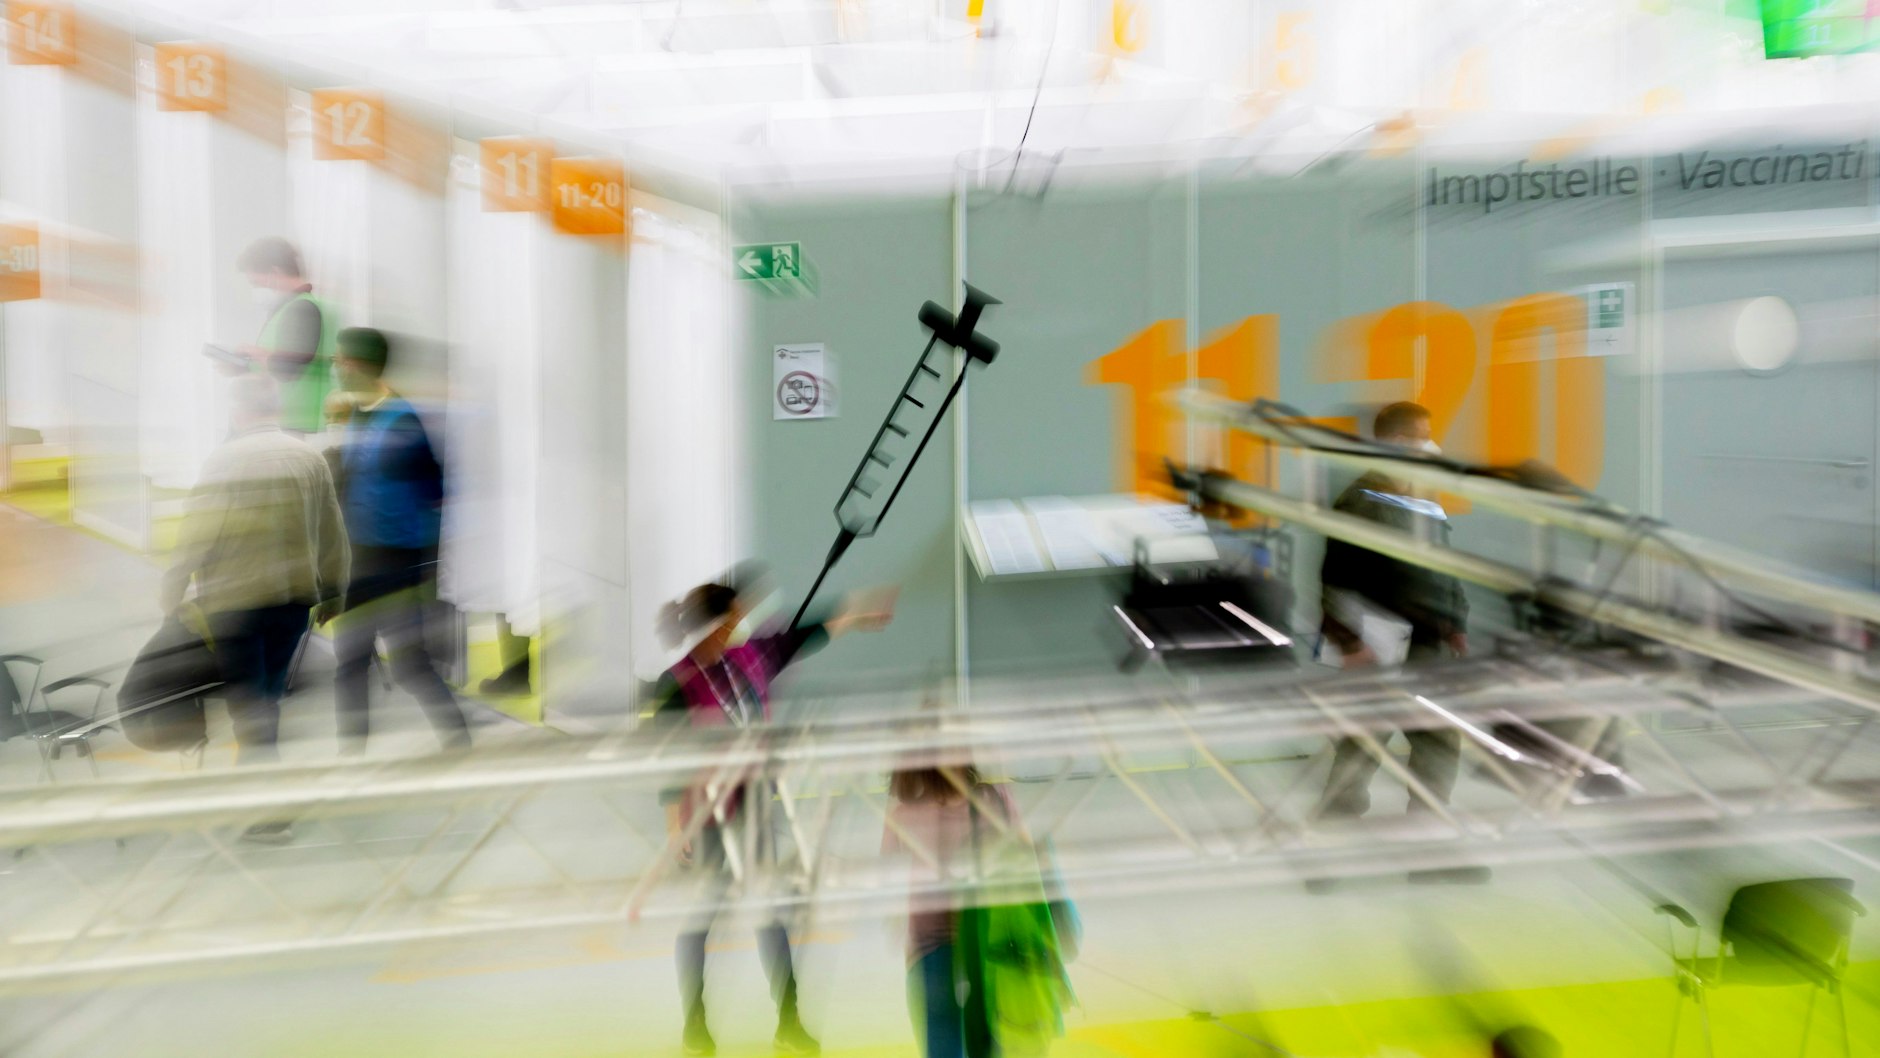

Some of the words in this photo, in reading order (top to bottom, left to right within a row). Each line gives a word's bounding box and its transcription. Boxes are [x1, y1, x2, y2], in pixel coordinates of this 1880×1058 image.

[18, 10, 64, 51] 14
[167, 54, 215, 98] 13
[323, 101, 374, 145] 12
[497, 151, 539, 197] 11
[557, 181, 621, 208] 11-20
[1428, 156, 1640, 213] Impfstelle
[1676, 139, 1880, 190] Vaccinati
[1092, 293, 1605, 528] 11-20
